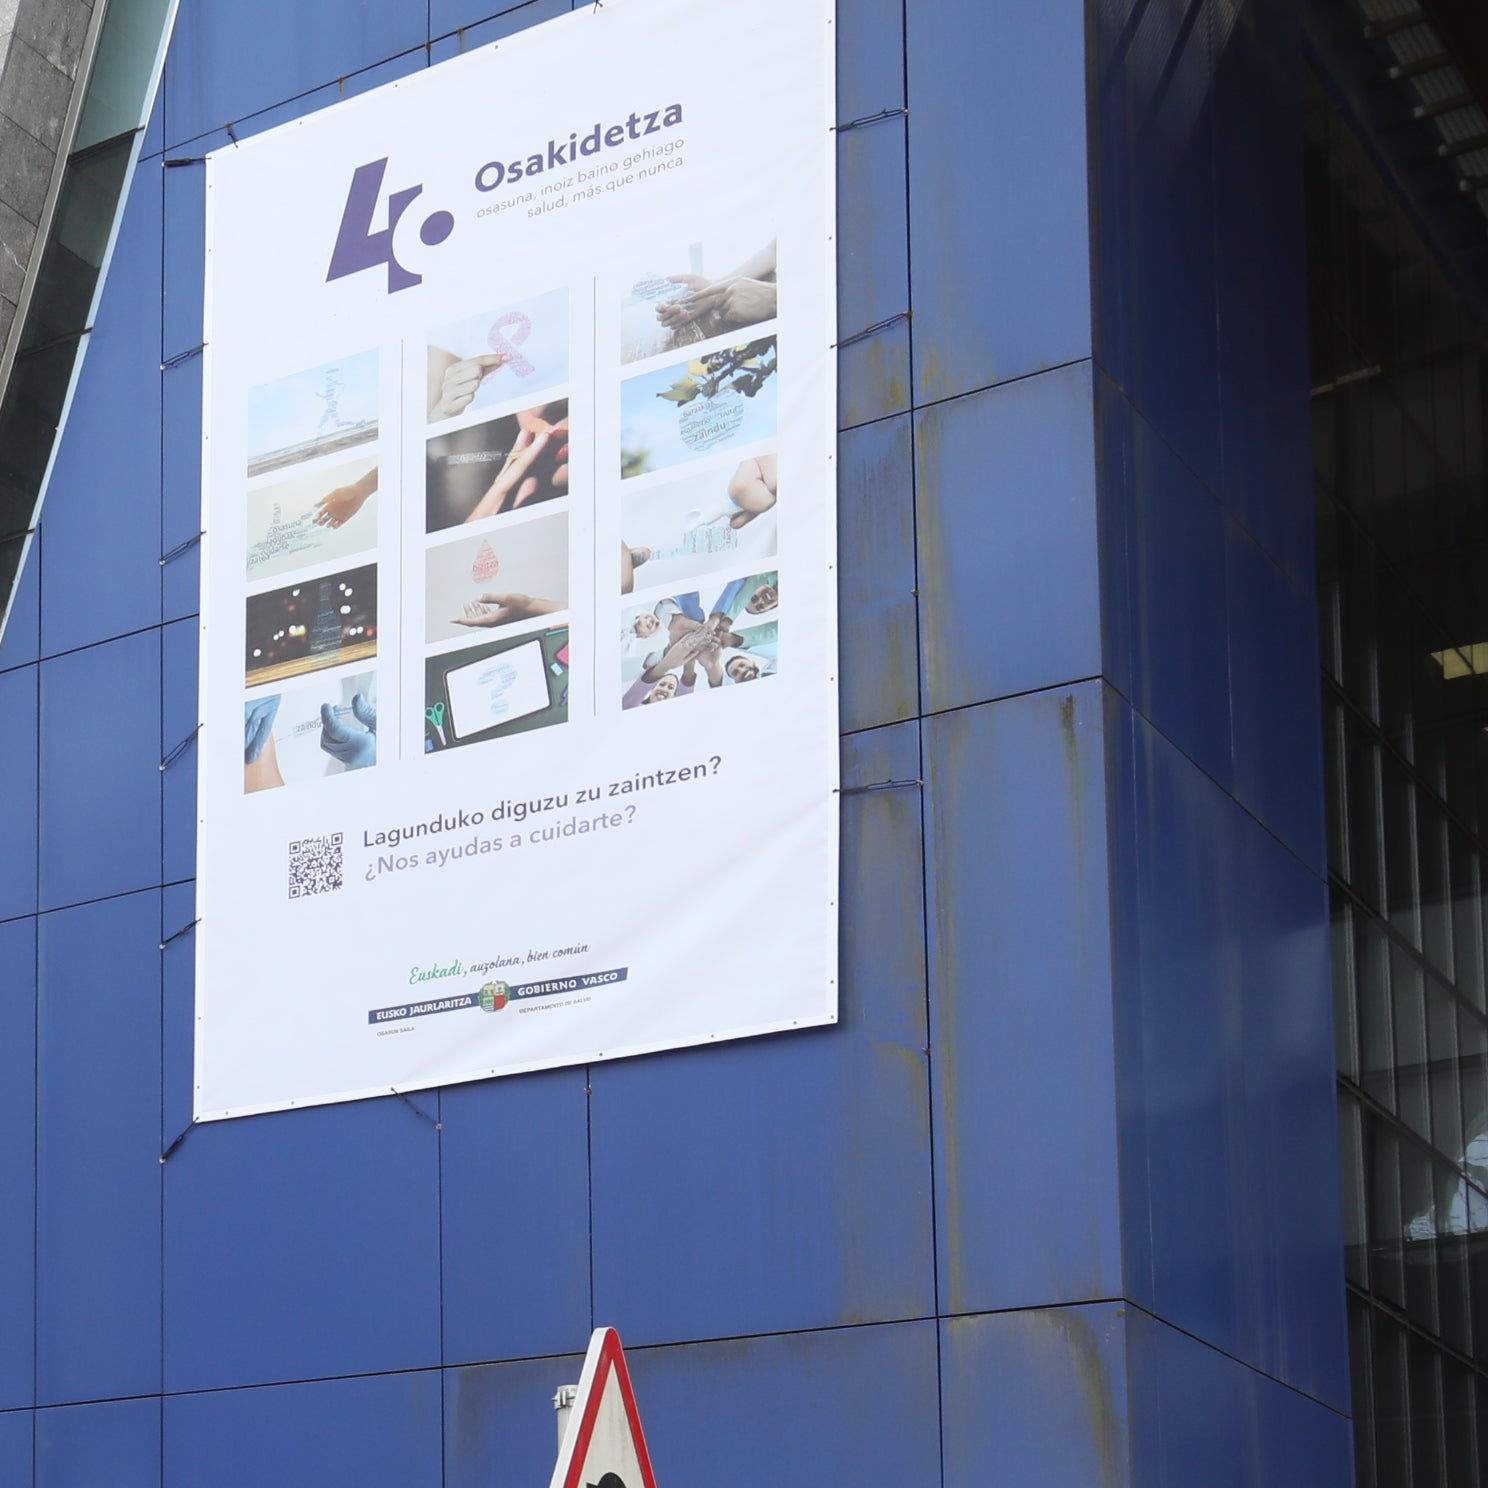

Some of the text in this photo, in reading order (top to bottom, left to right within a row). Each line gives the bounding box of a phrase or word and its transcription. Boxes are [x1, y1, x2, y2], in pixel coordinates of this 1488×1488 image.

[475, 103, 683, 192] Osakidetza
[477, 138, 684, 219] osasuna, inoiz baino gehiago
[527, 157, 683, 218] salud, más que nunca
[363, 756, 722, 848] Lagunduko diguzu zu zaintzen?
[365, 805, 637, 881] ¿Nos ayudas a cuidarte?
[517, 972, 618, 997] GOBIERNO VASCO
[527, 949, 549, 963] bien
[552, 942, 590, 959] común
[376, 997, 472, 1021] EUSKO JAURLARITZA
